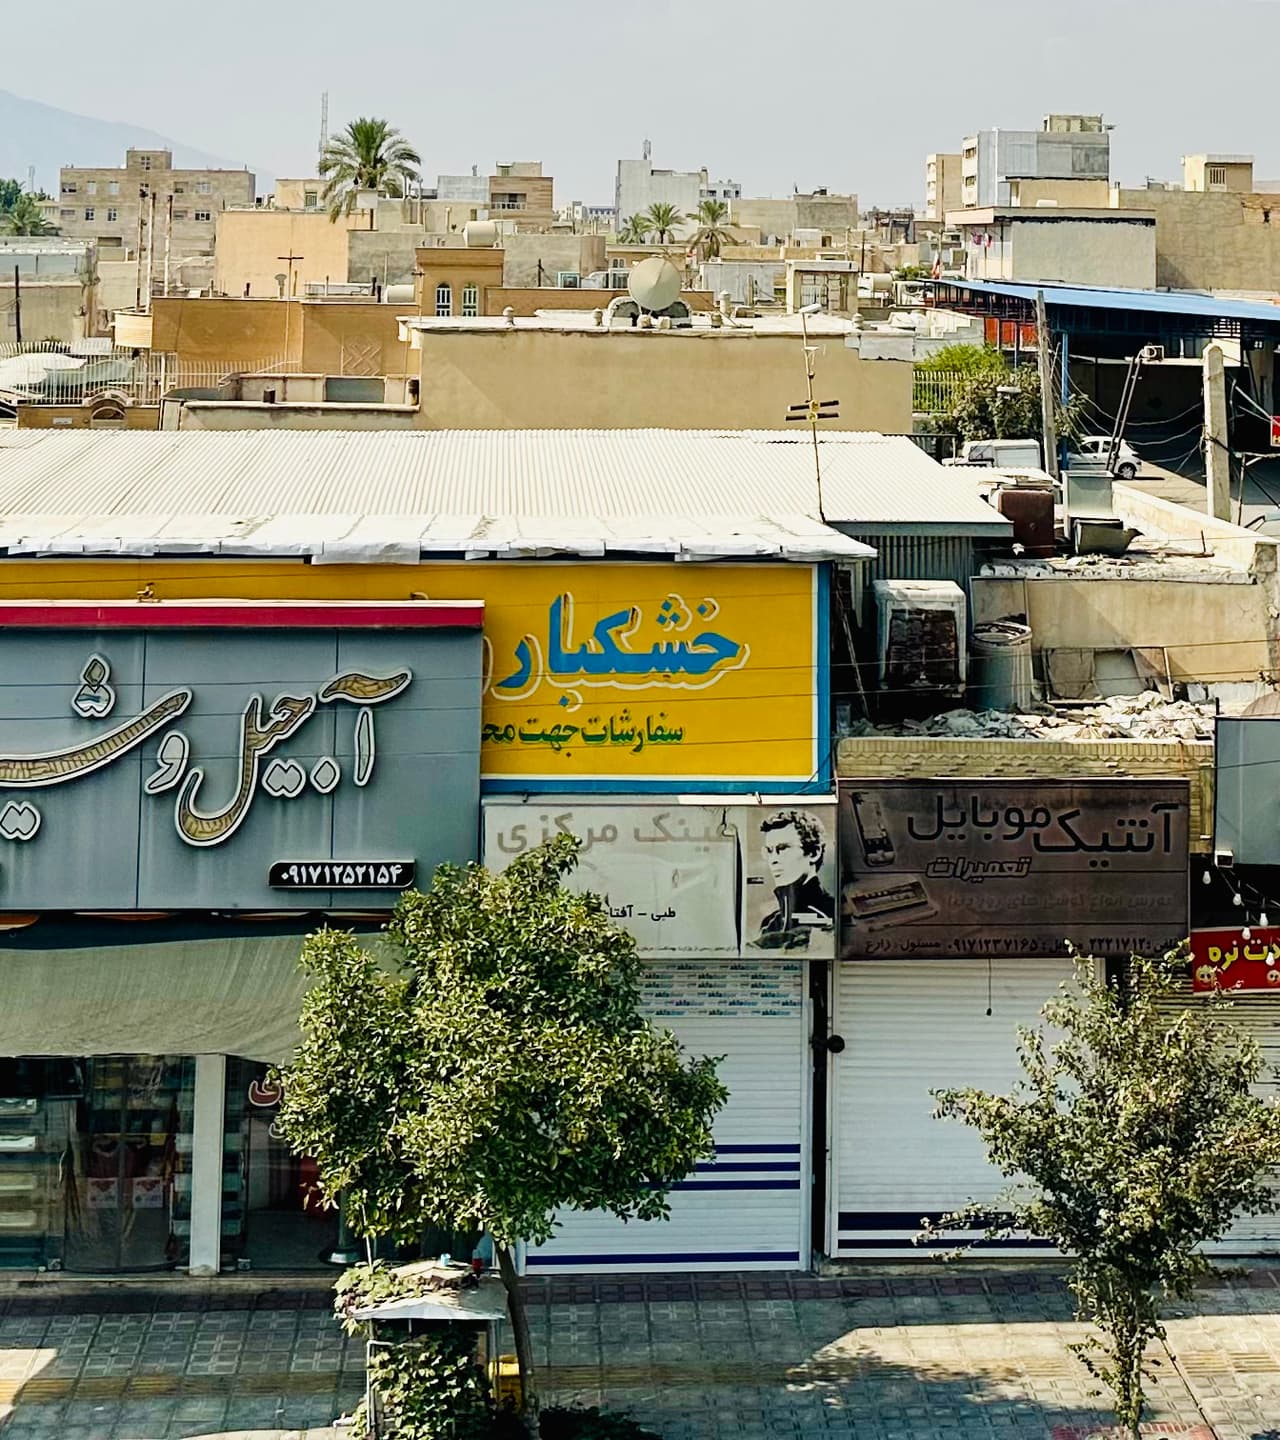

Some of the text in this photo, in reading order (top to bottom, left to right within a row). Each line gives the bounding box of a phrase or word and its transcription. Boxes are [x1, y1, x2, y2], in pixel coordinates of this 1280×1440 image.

[494, 592, 750, 712] خشکبار
[519, 717, 581, 757] جهت
[581, 709, 684, 755] سفارشات
[144, 729, 191, 795] و
[175, 666, 414, 848] آجیل
[907, 794, 1180, 869] آنتیک موبایل
[280, 863, 403, 885] ۰۹۱۷۱۲۵۲۱۵۴
[925, 856, 1033, 884] تعمیرات
[650, 906, 677, 922] طبی
[1208, 939, 1239, 971] نره
